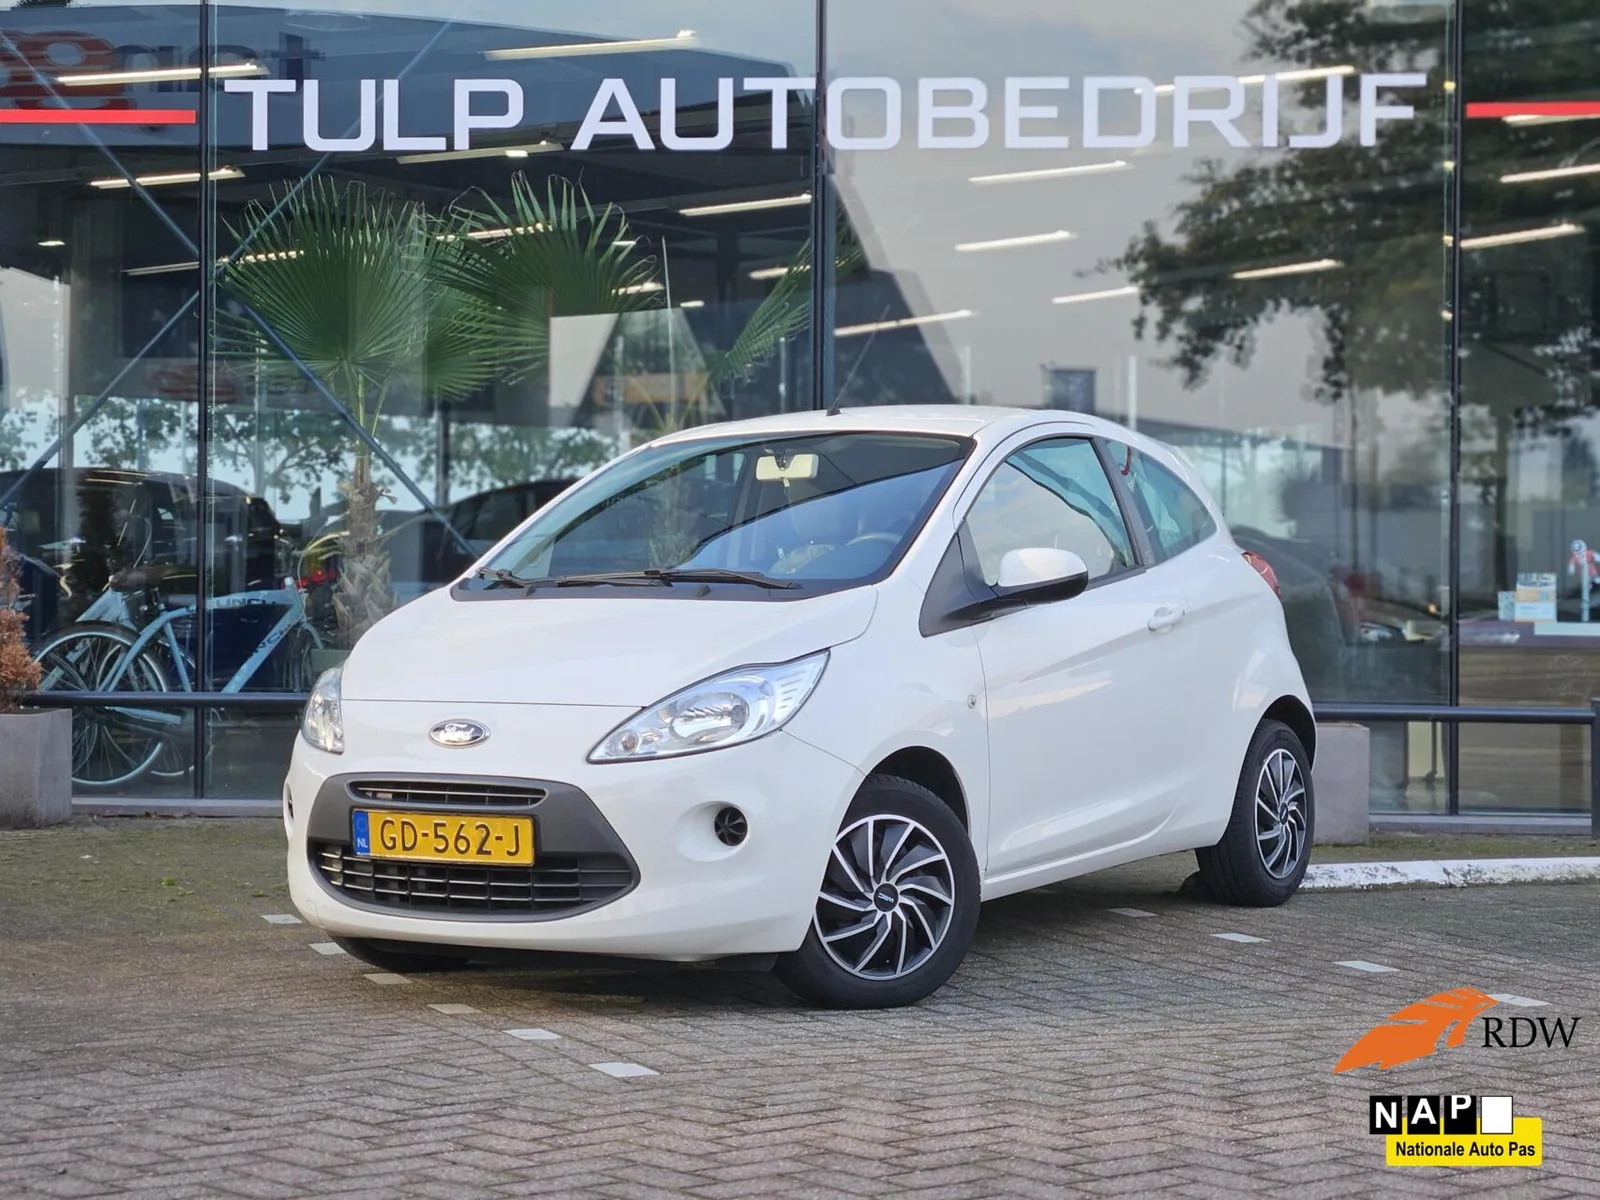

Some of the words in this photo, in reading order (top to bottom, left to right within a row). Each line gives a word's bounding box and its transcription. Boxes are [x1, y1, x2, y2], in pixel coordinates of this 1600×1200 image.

[224, 78, 524, 152] TULP
[570, 73, 1427, 151] AUTOBEDRIJF
[356, 837, 369, 849] NL
[380, 818, 520, 857] GD-562-J
